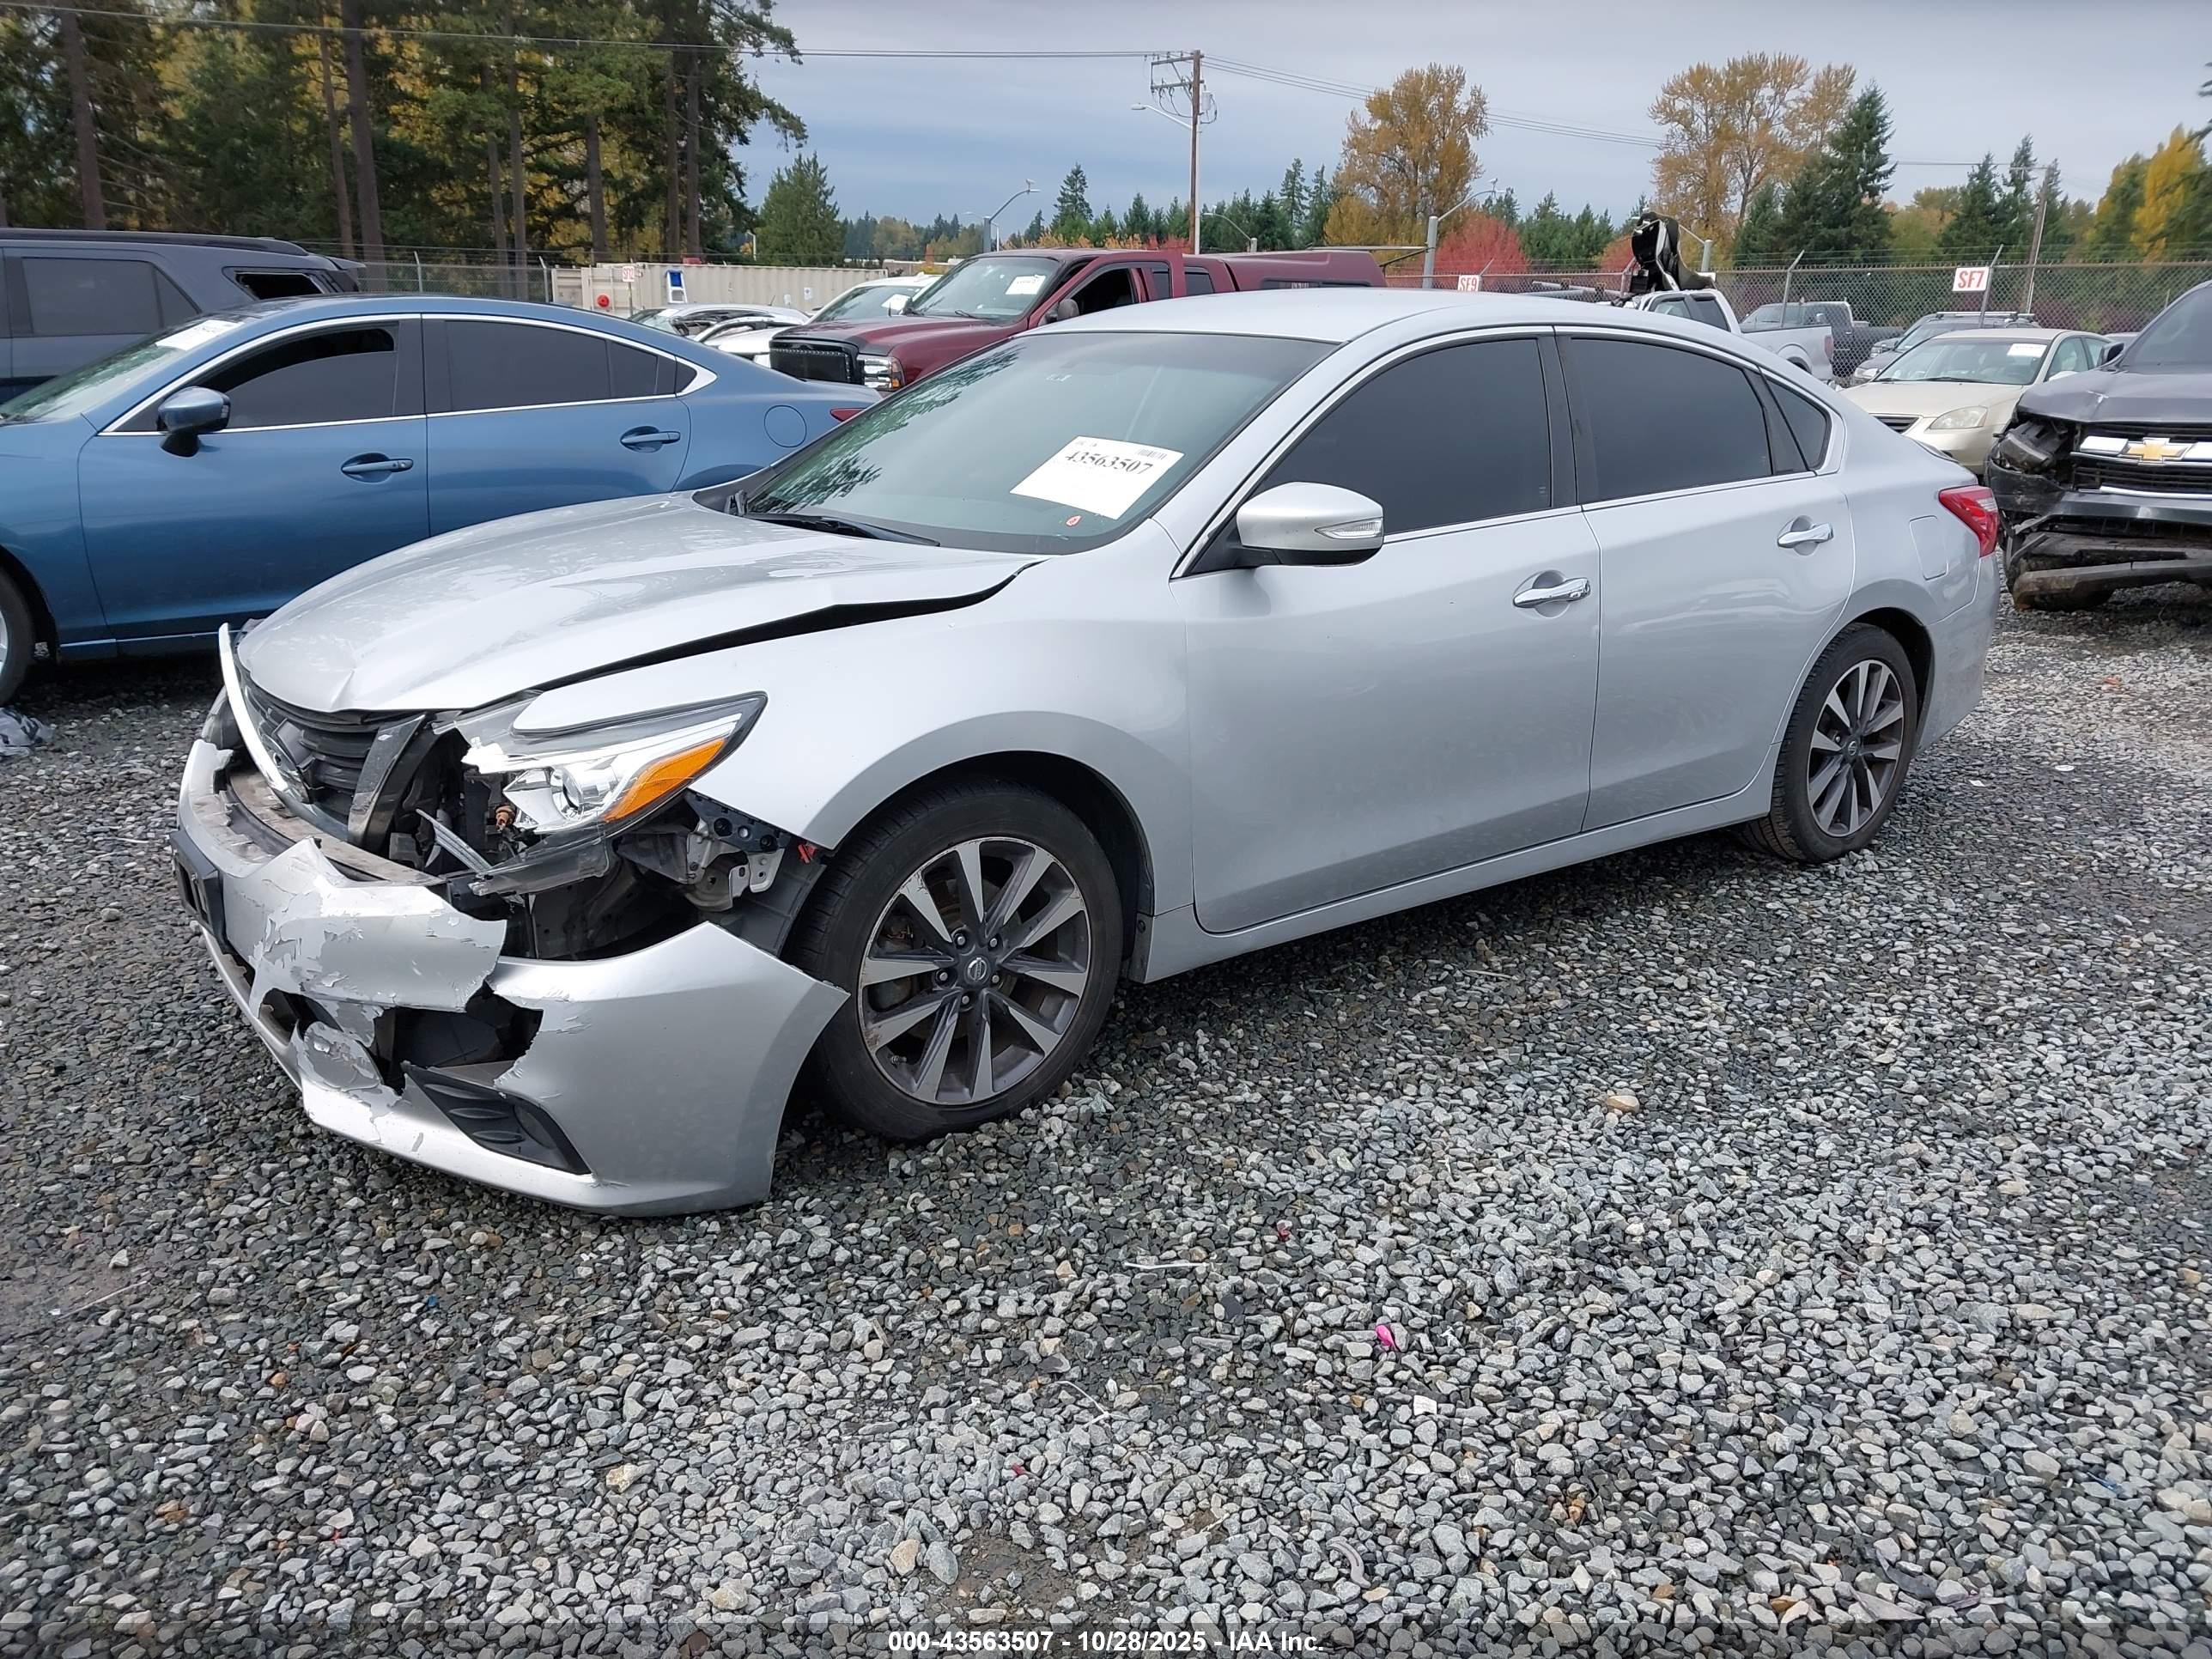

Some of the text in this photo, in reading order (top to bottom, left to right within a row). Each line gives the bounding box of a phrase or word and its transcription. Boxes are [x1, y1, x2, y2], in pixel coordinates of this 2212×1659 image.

[1460, 277, 1478, 292] SF9
[1958, 270, 1985, 289] SF7
[1065, 451, 1153, 474] 43563507
